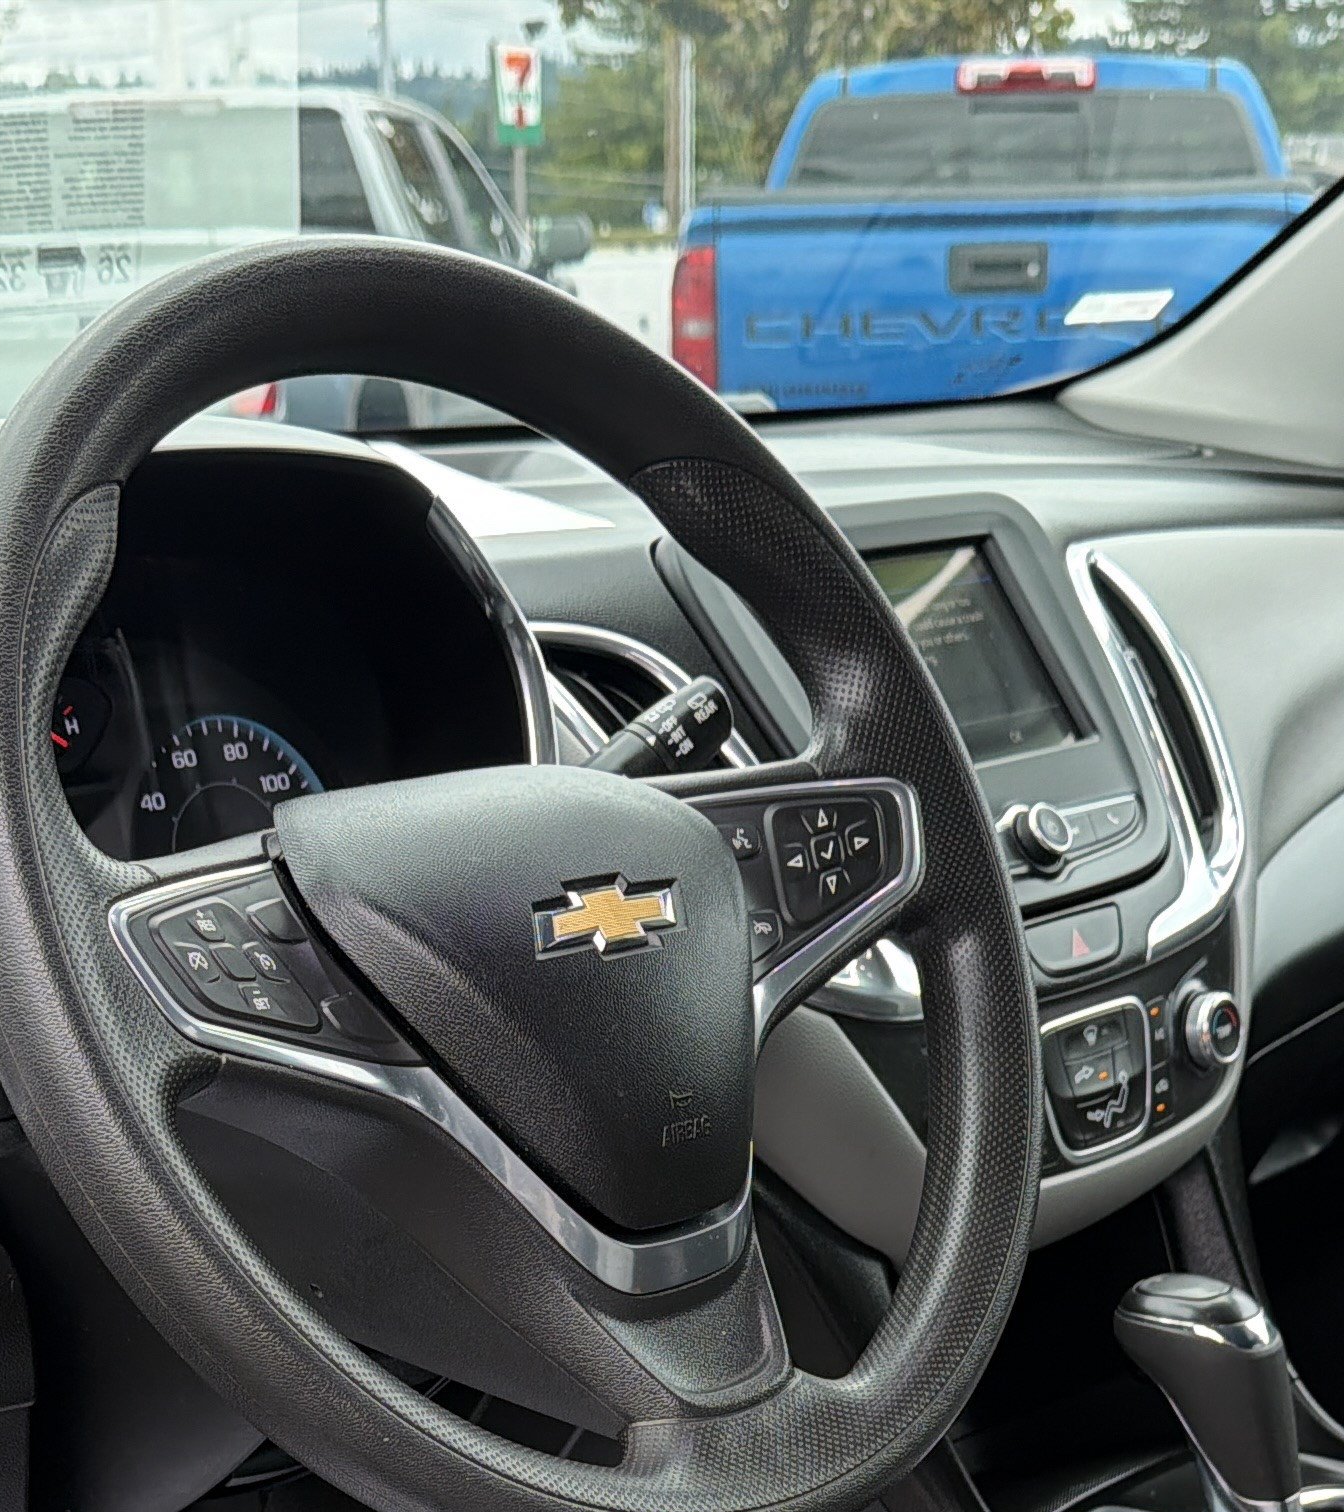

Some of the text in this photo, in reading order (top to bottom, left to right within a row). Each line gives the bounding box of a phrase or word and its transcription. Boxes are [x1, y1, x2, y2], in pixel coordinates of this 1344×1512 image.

[694, 699, 718, 724] REAR
[171, 750, 198, 769] 60
[222, 742, 249, 762] 80
[259, 772, 290, 794] 100
[140, 791, 166, 812] 40
[661, 1115, 712, 1148] AIRBAG
